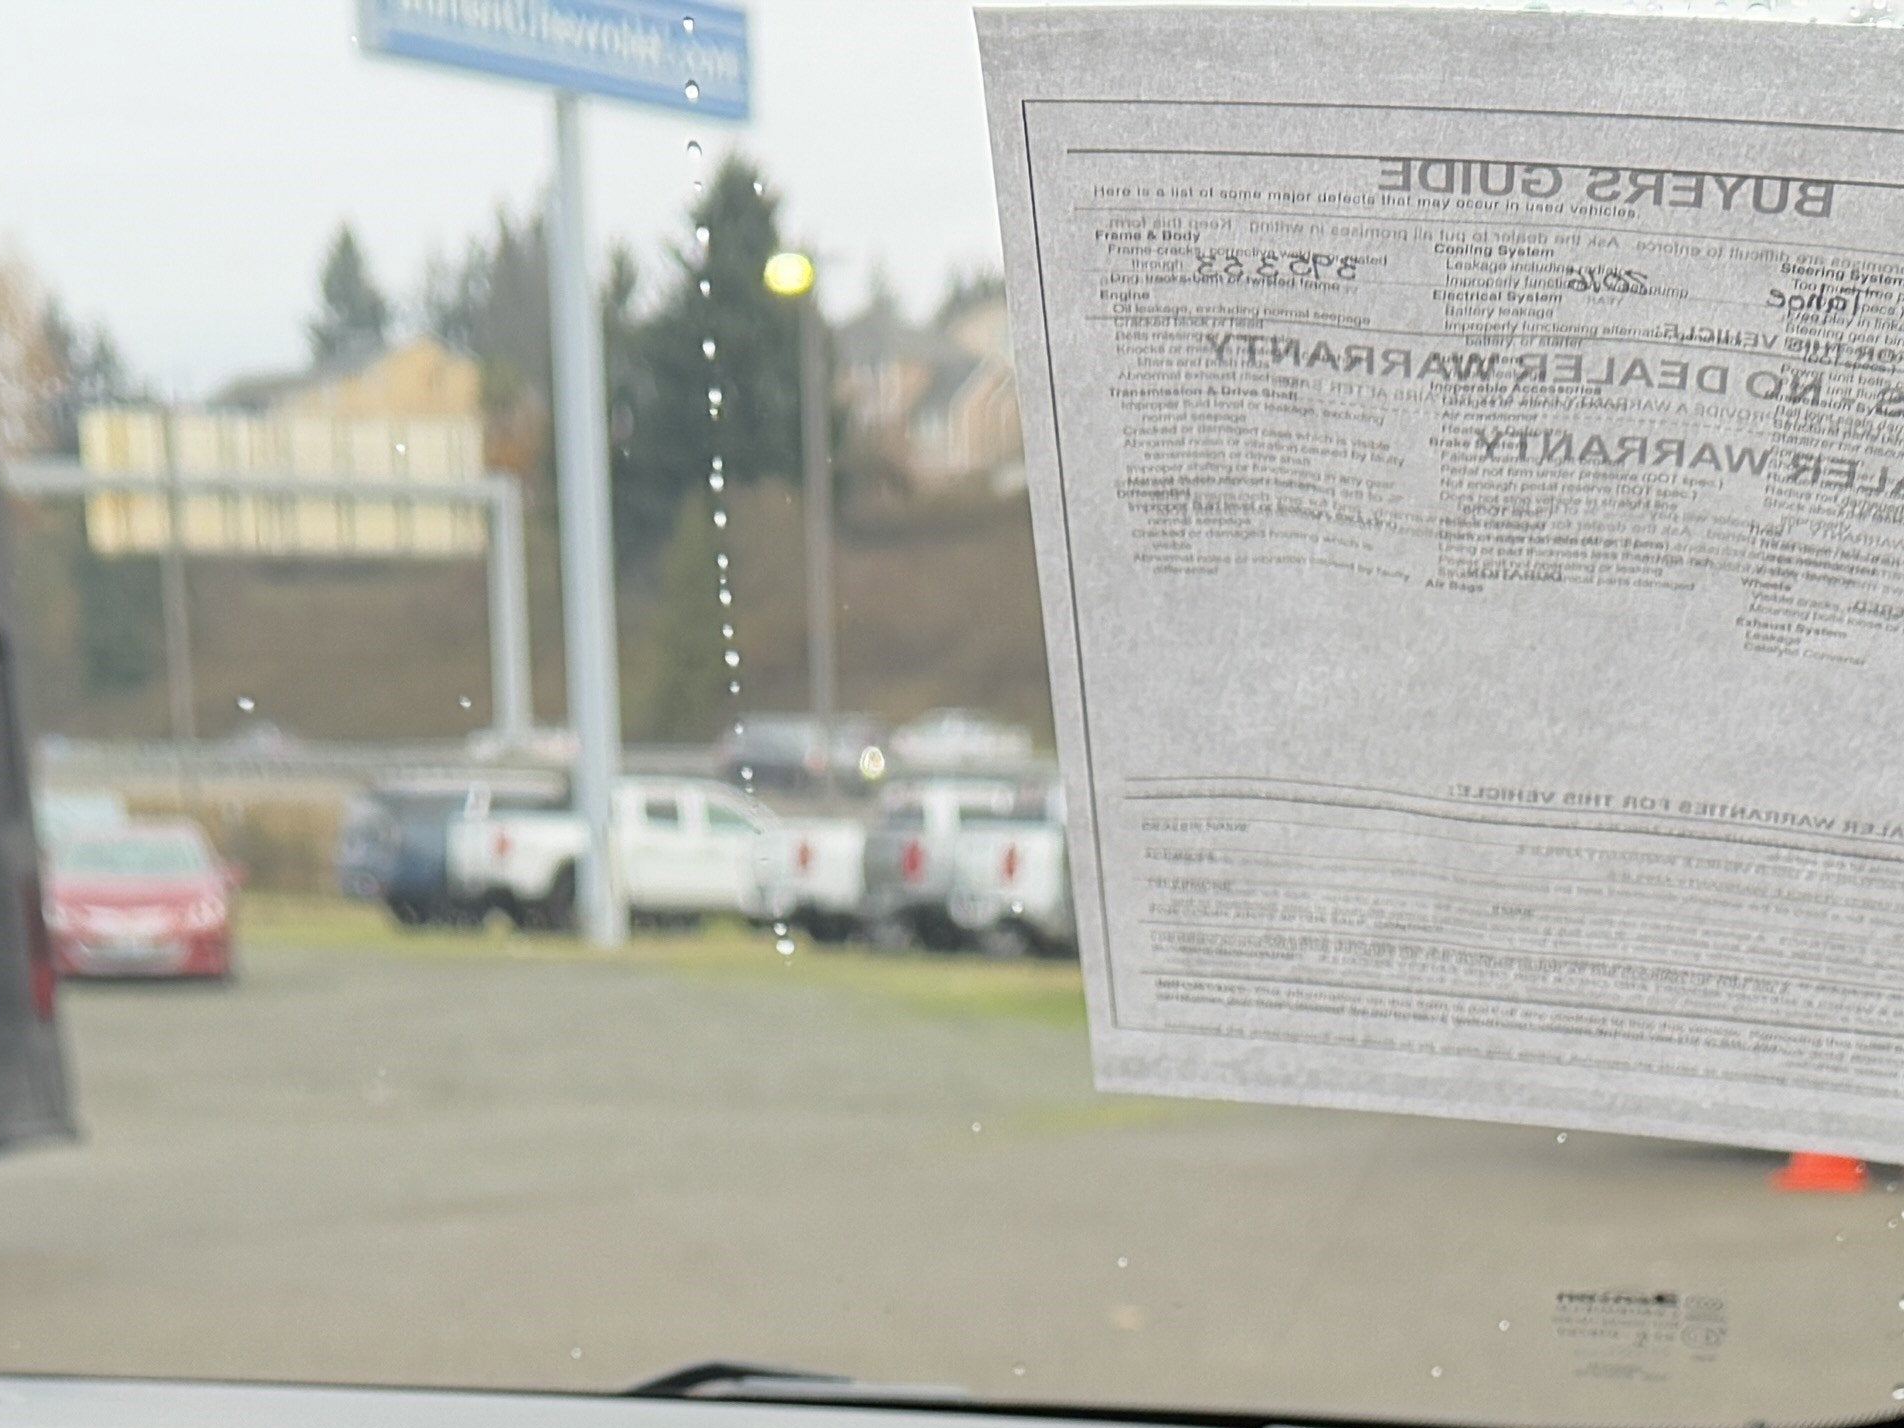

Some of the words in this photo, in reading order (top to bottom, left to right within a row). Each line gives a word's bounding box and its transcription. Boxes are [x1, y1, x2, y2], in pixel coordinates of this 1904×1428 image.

[1138, 187, 1149, 198] is
[1156, 189, 1165, 198] a
[1171, 186, 1194, 198] list
[1199, 187, 1214, 198] of
[1220, 190, 1262, 200] some
[1268, 189, 1311, 204] major
[1381, 193, 1411, 207] that
[1417, 197, 1450, 210] may
[1456, 199, 1499, 211] occur
[1505, 200, 1519, 212] in
[1525, 201, 1564, 214] used
[1497, 245, 1555, 261] System
[1446, 259, 1507, 274] Leakage
[1100, 289, 1151, 301] Engine
[1433, 290, 1502, 303] Electrical
[1506, 291, 1563, 304] System
